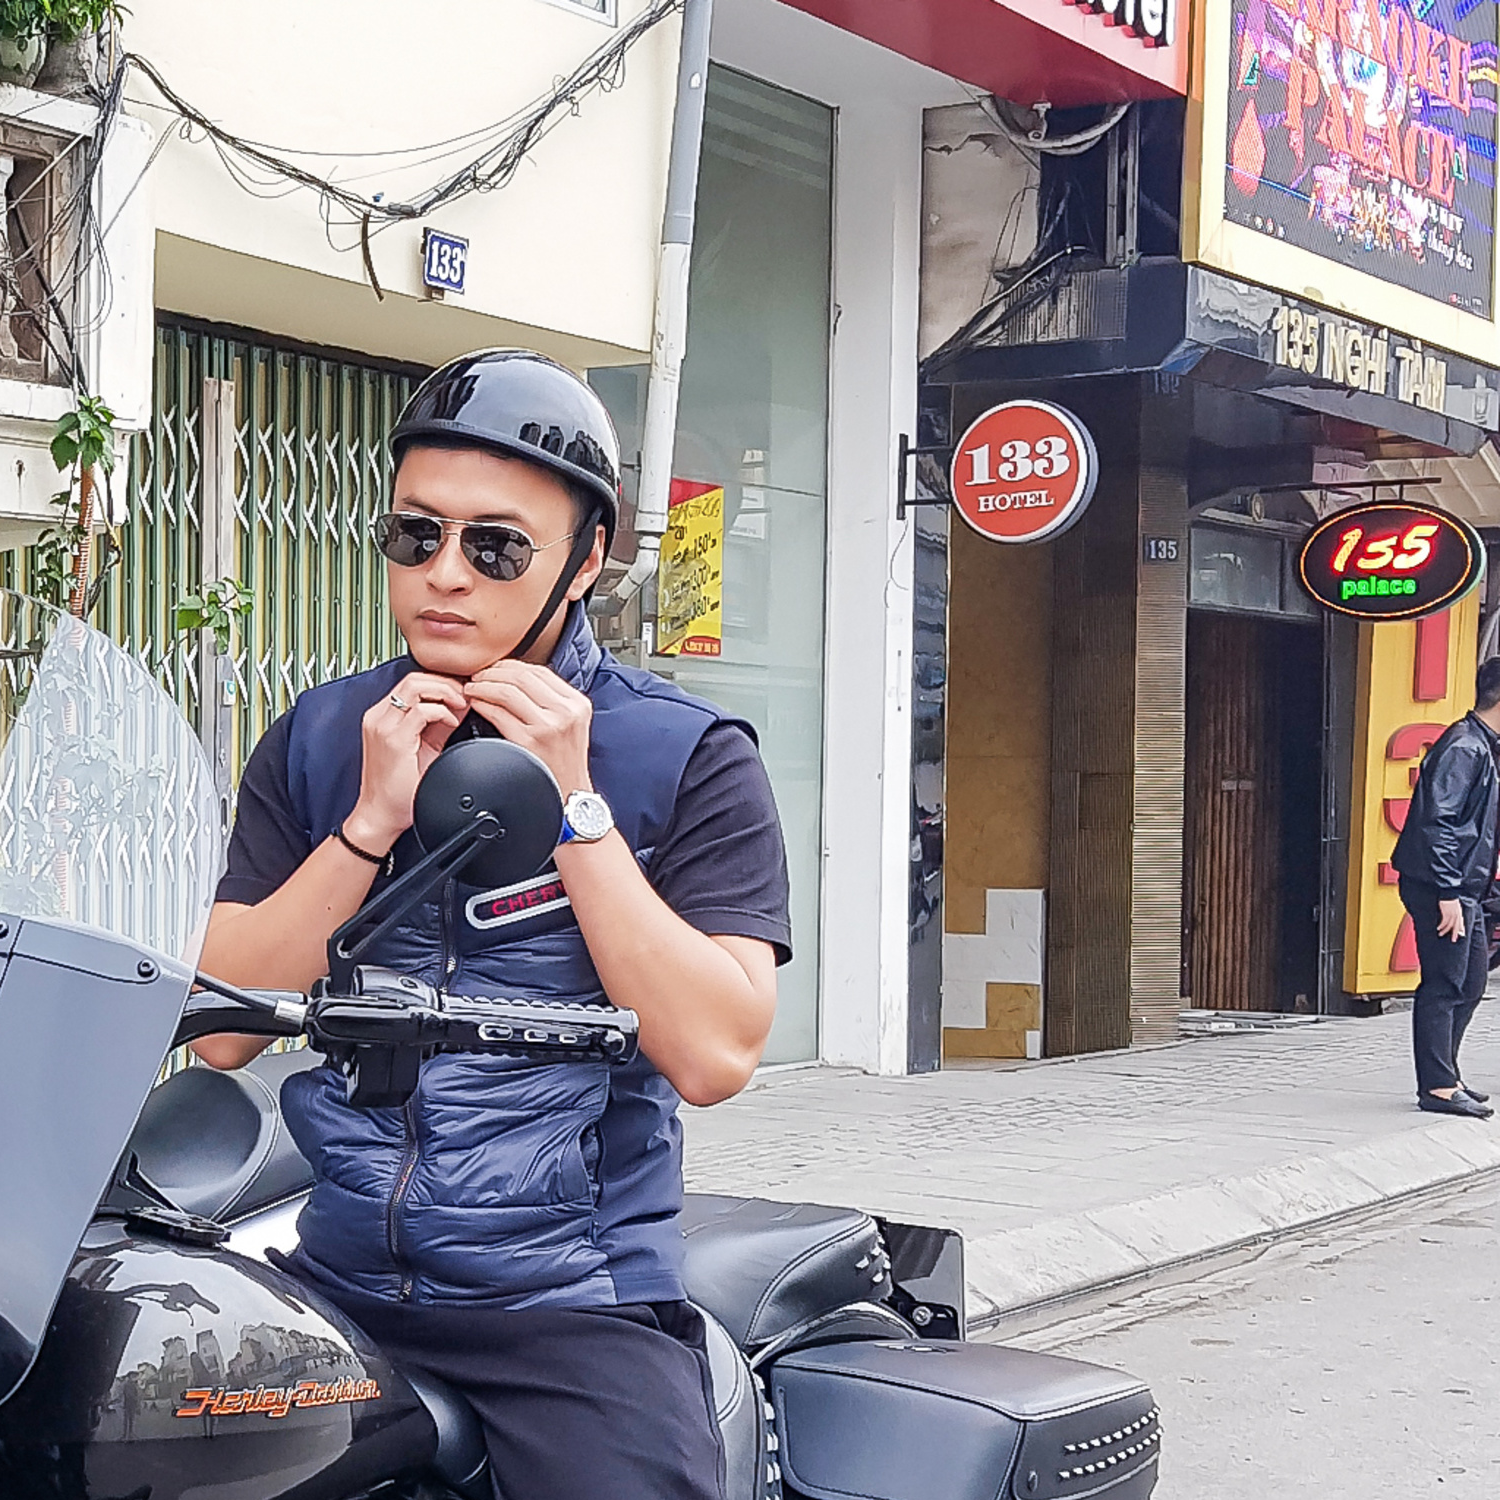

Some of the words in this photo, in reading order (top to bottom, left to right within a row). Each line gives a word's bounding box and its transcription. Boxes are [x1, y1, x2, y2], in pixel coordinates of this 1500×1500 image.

[429, 240, 463, 284] 133
[1272, 305, 1320, 375] 135
[964, 435, 1071, 486] 133
[977, 489, 1054, 512] HOTEL
[1149, 539, 1178, 560] 135
[1341, 575, 1417, 600] palace
[491, 881, 568, 916] CHER
